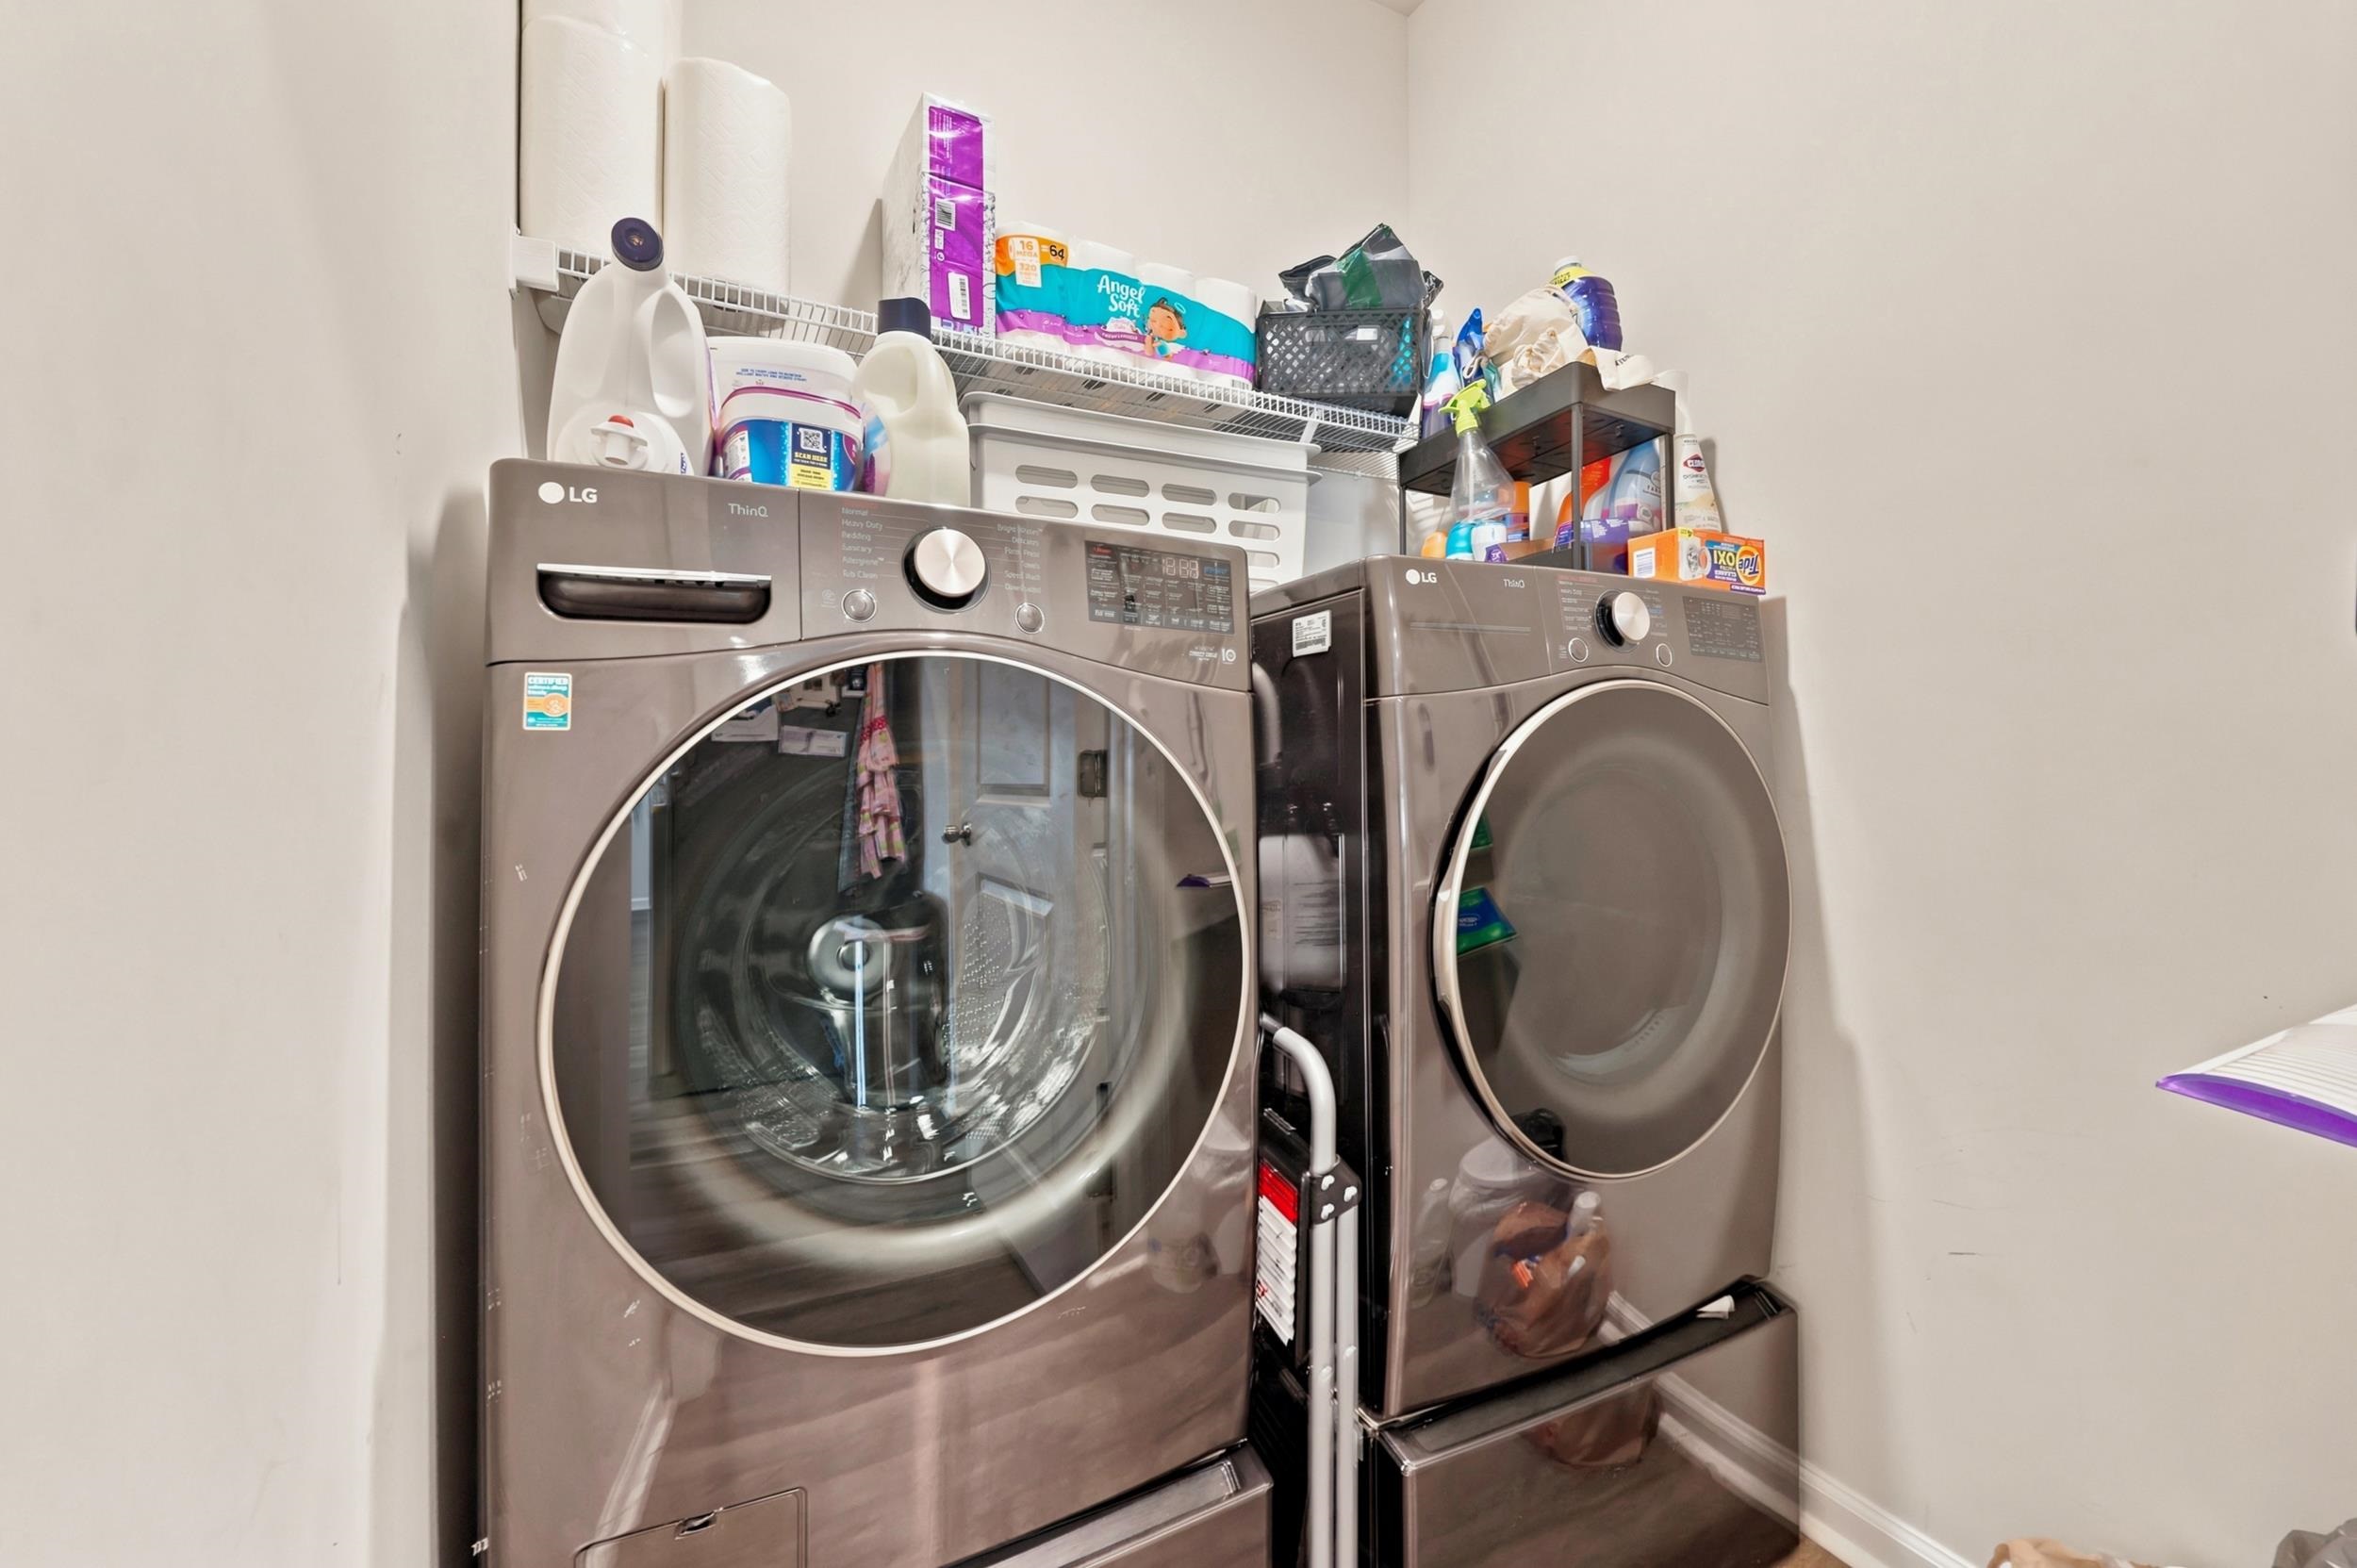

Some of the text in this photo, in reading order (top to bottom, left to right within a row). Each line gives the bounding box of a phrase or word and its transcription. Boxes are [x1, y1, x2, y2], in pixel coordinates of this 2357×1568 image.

[1019, 240, 1034, 251] 16
[1049, 244, 1065, 260] 64
[1096, 274, 1146, 305] Angel
[1108, 292, 1140, 318] Soft
[569, 487, 598, 503] LG
[728, 503, 768, 518] ThinQ
[1713, 550, 1735, 566] OXI
[1738, 553, 1760, 576] Tide
[1421, 571, 1438, 584] LG
[1503, 578, 1525, 589] ThinQ
